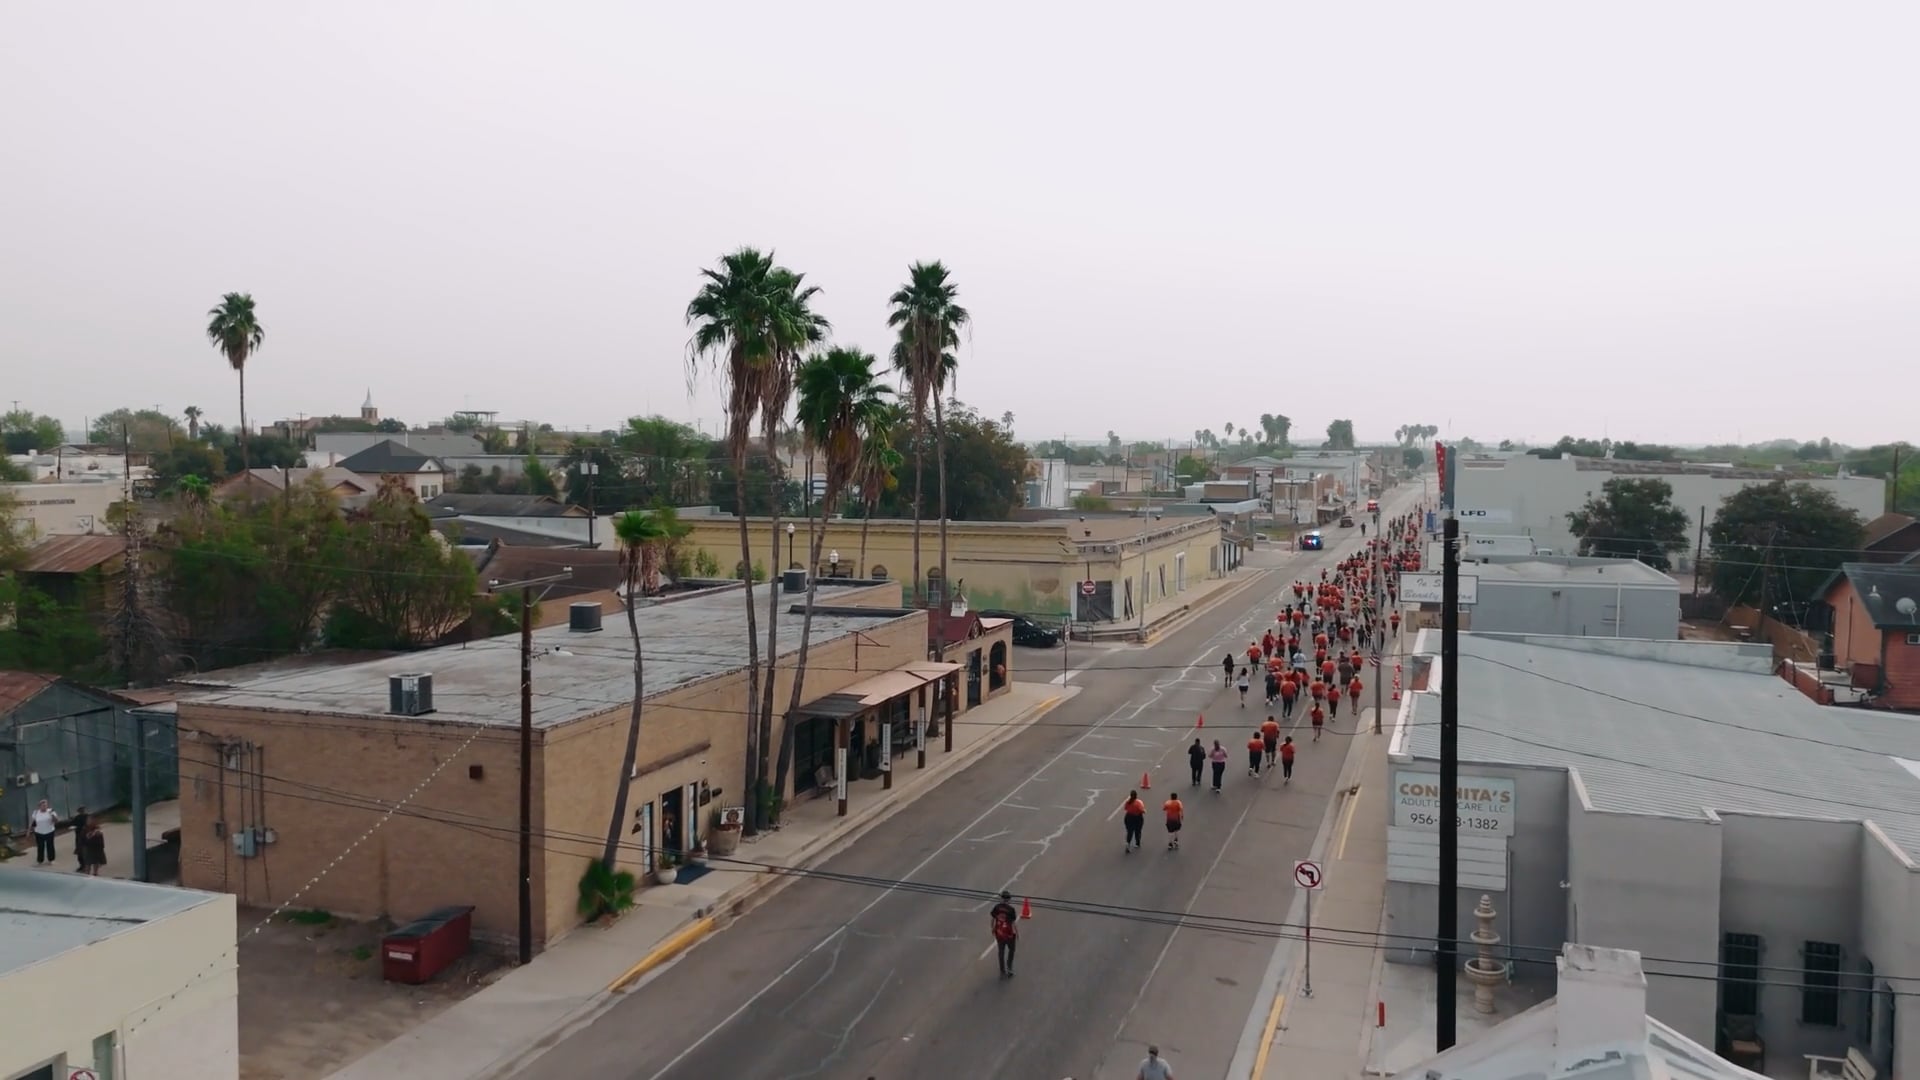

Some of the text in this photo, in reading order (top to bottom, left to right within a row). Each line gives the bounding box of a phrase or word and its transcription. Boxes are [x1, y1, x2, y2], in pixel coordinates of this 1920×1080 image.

[1400, 783, 1511, 803] CONITA'S
[1401, 798, 1430, 807] ADULT
[1489, 805, 1507, 814] LLC
